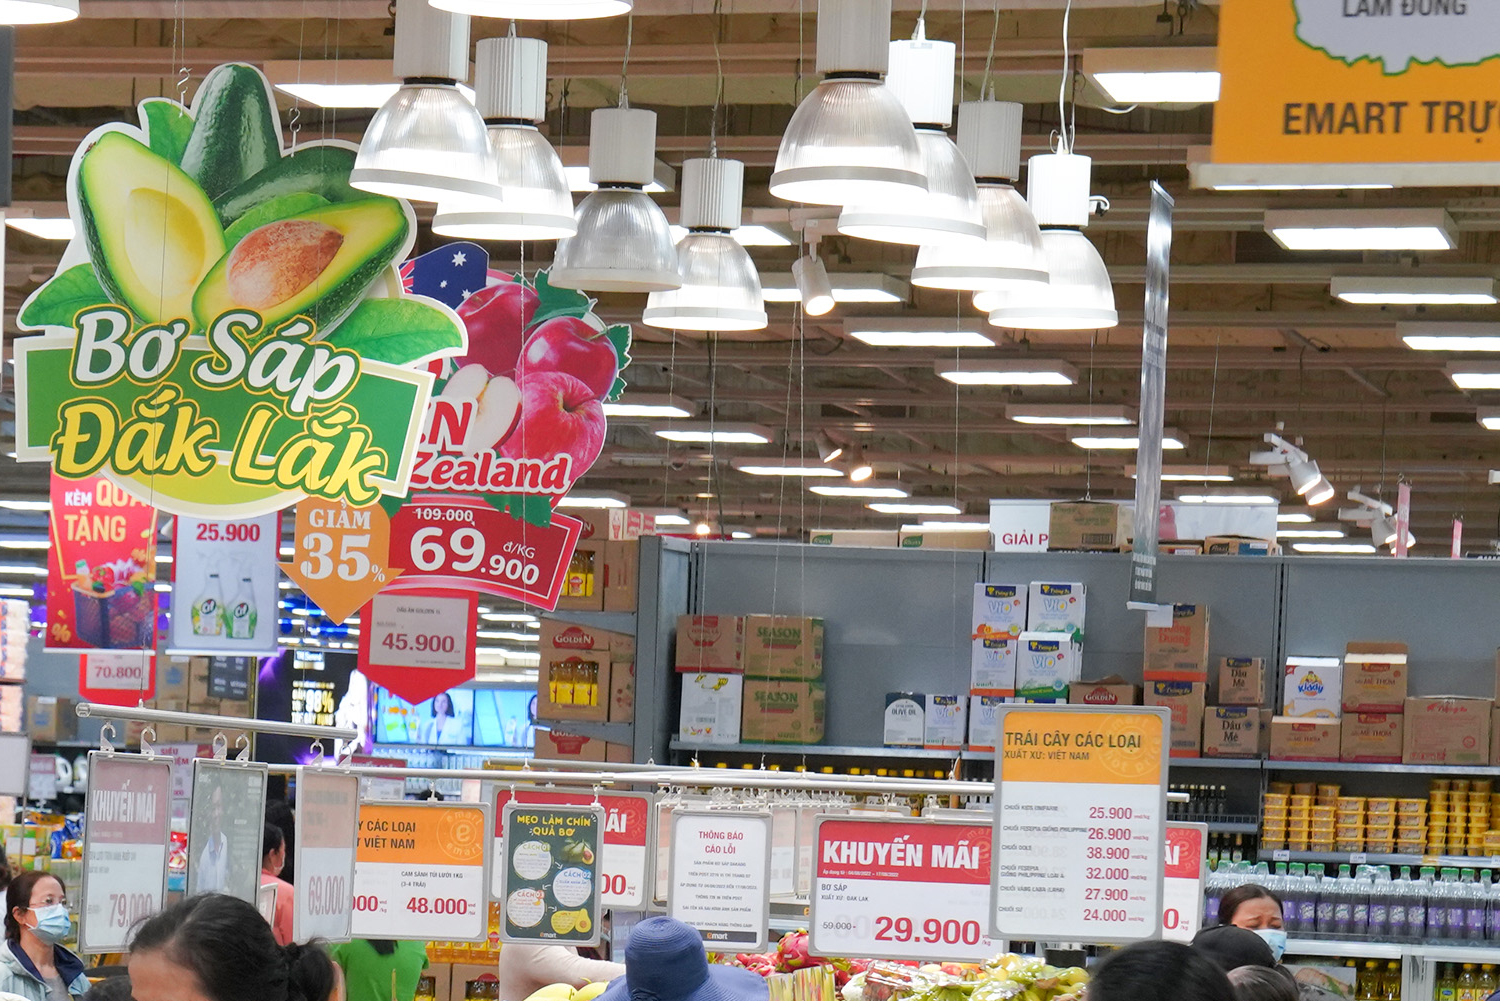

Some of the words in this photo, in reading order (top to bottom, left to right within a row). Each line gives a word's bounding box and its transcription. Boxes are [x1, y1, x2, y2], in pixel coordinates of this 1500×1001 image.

[1282, 102, 1408, 135] EMART
[1422, 98, 1500, 143] TRỰ
[75, 309, 184, 384] Bơ
[198, 309, 360, 411] Sáp
[56, 388, 216, 477] Đắk
[232, 405, 387, 503] Lắk
[410, 451, 570, 490] Zealand
[64, 488, 93, 507] KÈM
[309, 500, 372, 530] GIẢM
[414, 507, 474, 522] 109.000
[64, 510, 127, 546] TẶNG
[197, 523, 261, 541] 25.900
[1002, 529, 1033, 545] GIẢI
[410, 526, 540, 586] 69.900
[503, 540, 536, 560] đ/KG
[555, 632, 594, 644] GOLDEN
[756, 626, 802, 639] SEASON
[382, 632, 455, 653] 45.900
[95, 665, 142, 680] 70.800
[754, 691, 799, 703] SEASON
[1085, 691, 1116, 702] GOLDEN
[1005, 730, 1038, 746] TRÁI
[1043, 731, 1071, 747] CÂY
[1075, 731, 1104, 748] CÁC
[1109, 734, 1142, 752] LOẠI
[1004, 749, 1028, 759] XUẤT
[1069, 751, 1090, 760] NAM
[91, 779, 134, 823] KHUYẾN
[135, 786, 157, 823] MÃI
[517, 814, 538, 825] MẸO
[542, 814, 563, 825] LÀM
[566, 815, 591, 827] CHÍN
[1089, 807, 1133, 819] 25.900
[367, 819, 388, 832] CÁC
[392, 822, 416, 836] LOẠI
[533, 825, 555, 836] QUẢ
[558, 828, 575, 837] BƠ
[1088, 827, 1131, 841] 26.900
[364, 835, 387, 851] VIỆT
[391, 838, 415, 849] NAM
[699, 830, 725, 840] THÔNG
[727, 831, 744, 841] BÁO
[705, 844, 721, 854] CÁO
[723, 843, 736, 854] LỖI
[823, 835, 923, 867] KHUYẾN
[931, 840, 979, 869] MÃI
[1086, 847, 1130, 860] 38.900
[564, 870, 582, 878] CÁCH
[1086, 867, 1129, 880] 32.000
[821, 883, 833, 891] BƠ
[833, 883, 848, 892] SÁP
[1085, 888, 1128, 901] 27.900
[308, 876, 345, 916] 69.000
[407, 897, 467, 915] 48.000
[1083, 909, 1126, 922] 24.000
[707, 932, 728, 940] emart
[875, 916, 981, 946] 29.900
